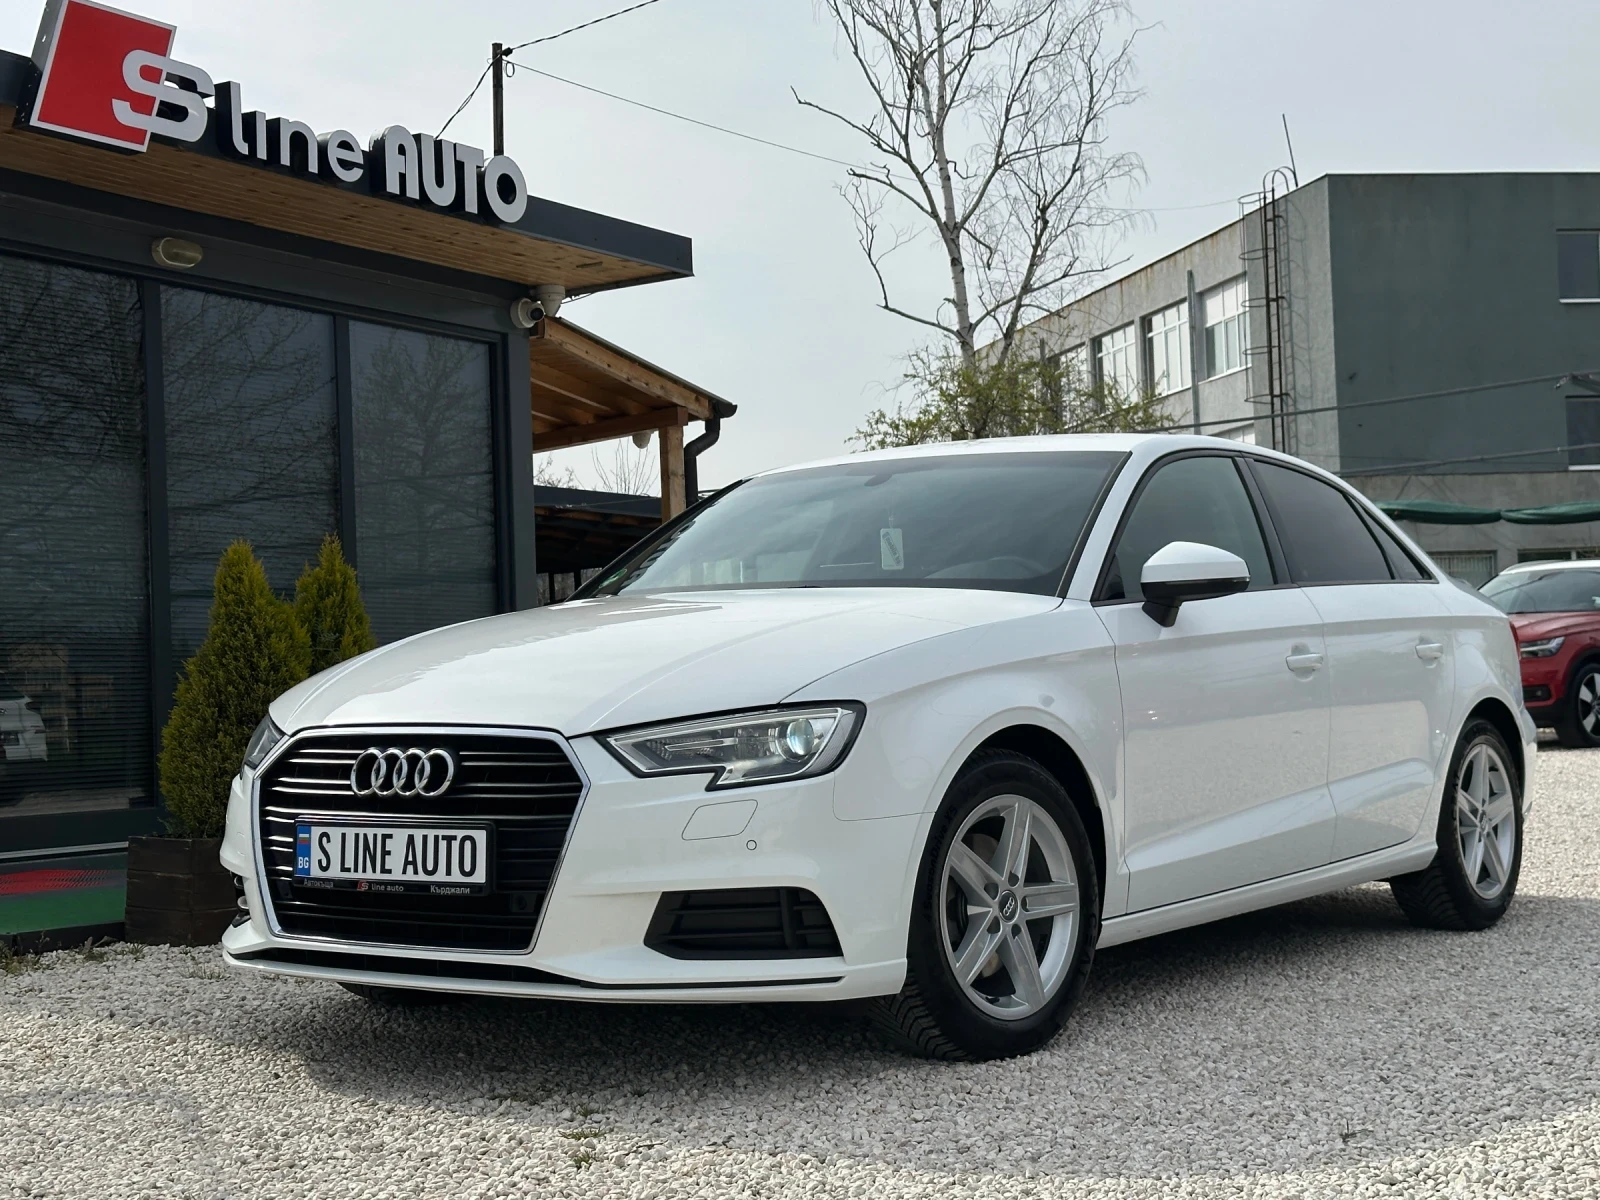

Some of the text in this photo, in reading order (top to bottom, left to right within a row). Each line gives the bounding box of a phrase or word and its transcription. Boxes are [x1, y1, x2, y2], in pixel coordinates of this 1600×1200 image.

[111, 49, 528, 223] S line AUTO
[298, 857, 309, 869] BG
[317, 831, 477, 877] S LINE AUTO
[430, 885, 470, 895] Кърджали
